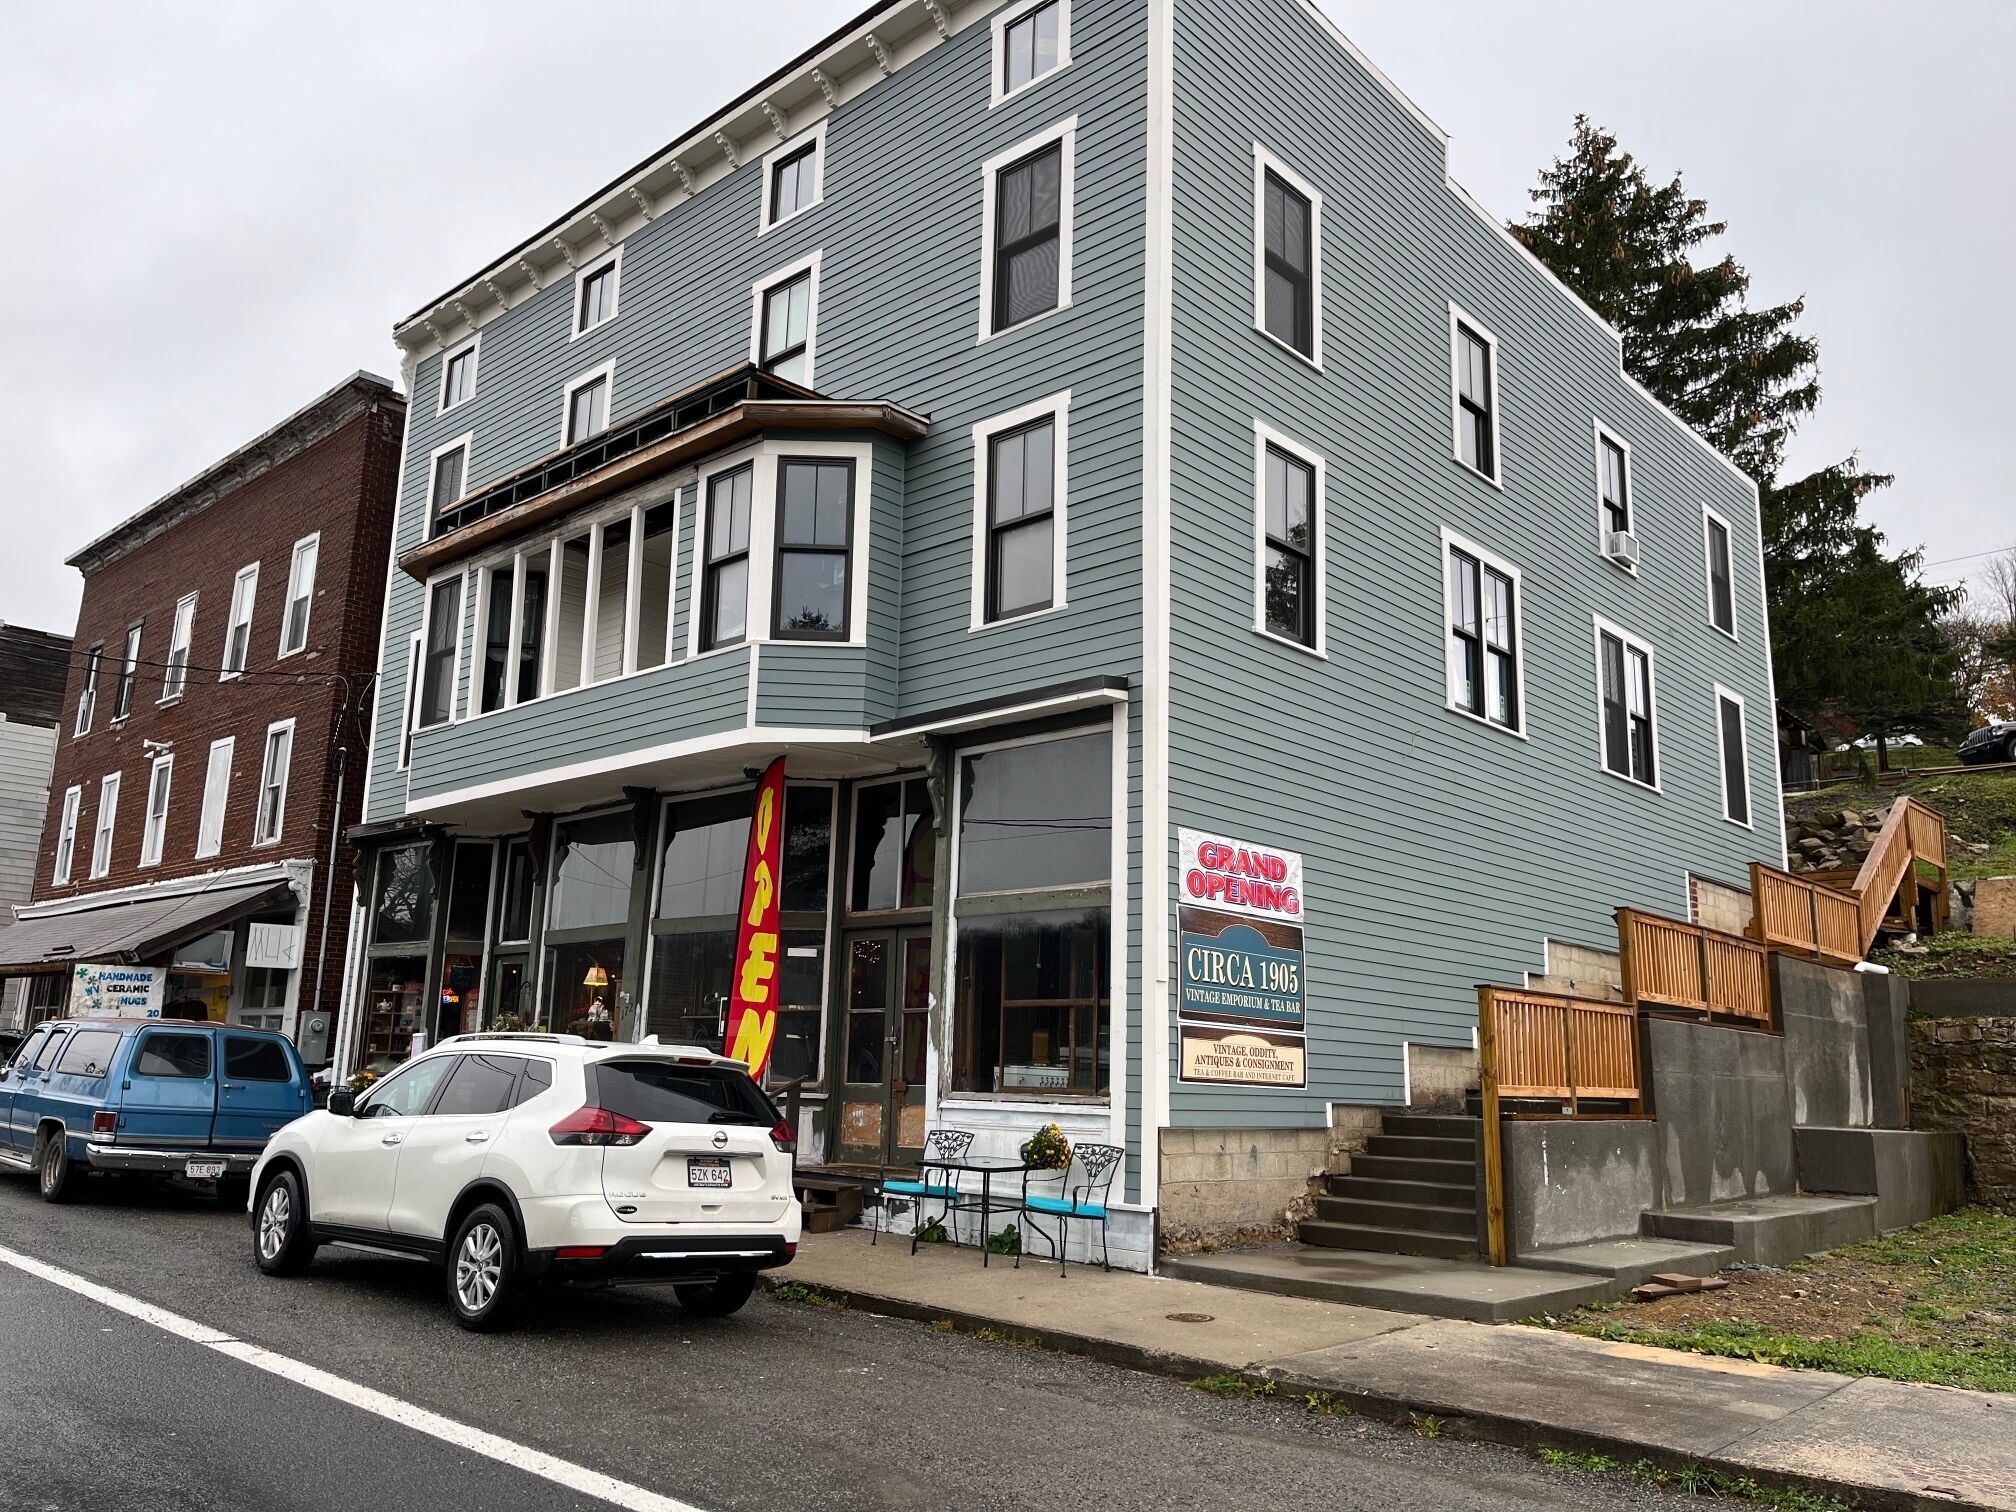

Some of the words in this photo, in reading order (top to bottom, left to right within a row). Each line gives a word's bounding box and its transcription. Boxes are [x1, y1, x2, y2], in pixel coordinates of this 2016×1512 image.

[1197, 841, 1287, 882] GRAND
[1186, 869, 1300, 915] OPENING
[731, 786, 777, 1076] OPEN
[98, 971, 153, 982] HANDMADE
[1187, 947, 1255, 988] CIRCA
[1260, 960, 1299, 994] 1905
[106, 984, 150, 993] CERAMIC
[120, 997, 147, 1006] MUGS
[1185, 988, 1221, 1004] VINTAGE
[1221, 992, 1263, 1009] EMPORIUM
[1264, 998, 1270, 1009] &
[1271, 999, 1286, 1012] TEA
[1286, 1001, 1301, 1014] BAR
[146, 1009, 160, 1018] 20
[1213, 1044, 1248, 1057] VINTAGE,
[1249, 1047, 1279, 1060] ODDITY,
[1194, 1054, 1234, 1068] ANTIQUES
[1235, 1058, 1242, 1067] &
[1242, 1059, 1294, 1071] CONSIGNMENT
[1193, 1068, 1205, 1076] TEA
[1210, 1069, 1232, 1077] COFFEE
[1244, 1071, 1256, 1079] AND
[1256, 1072, 1281, 1081] INTERNET
[1282, 1073, 1295, 1081] CAFE
[190, 1165, 204, 1174] 57E
[691, 1168, 709, 1181] 5ZK
[711, 1169, 729, 1182] 642
